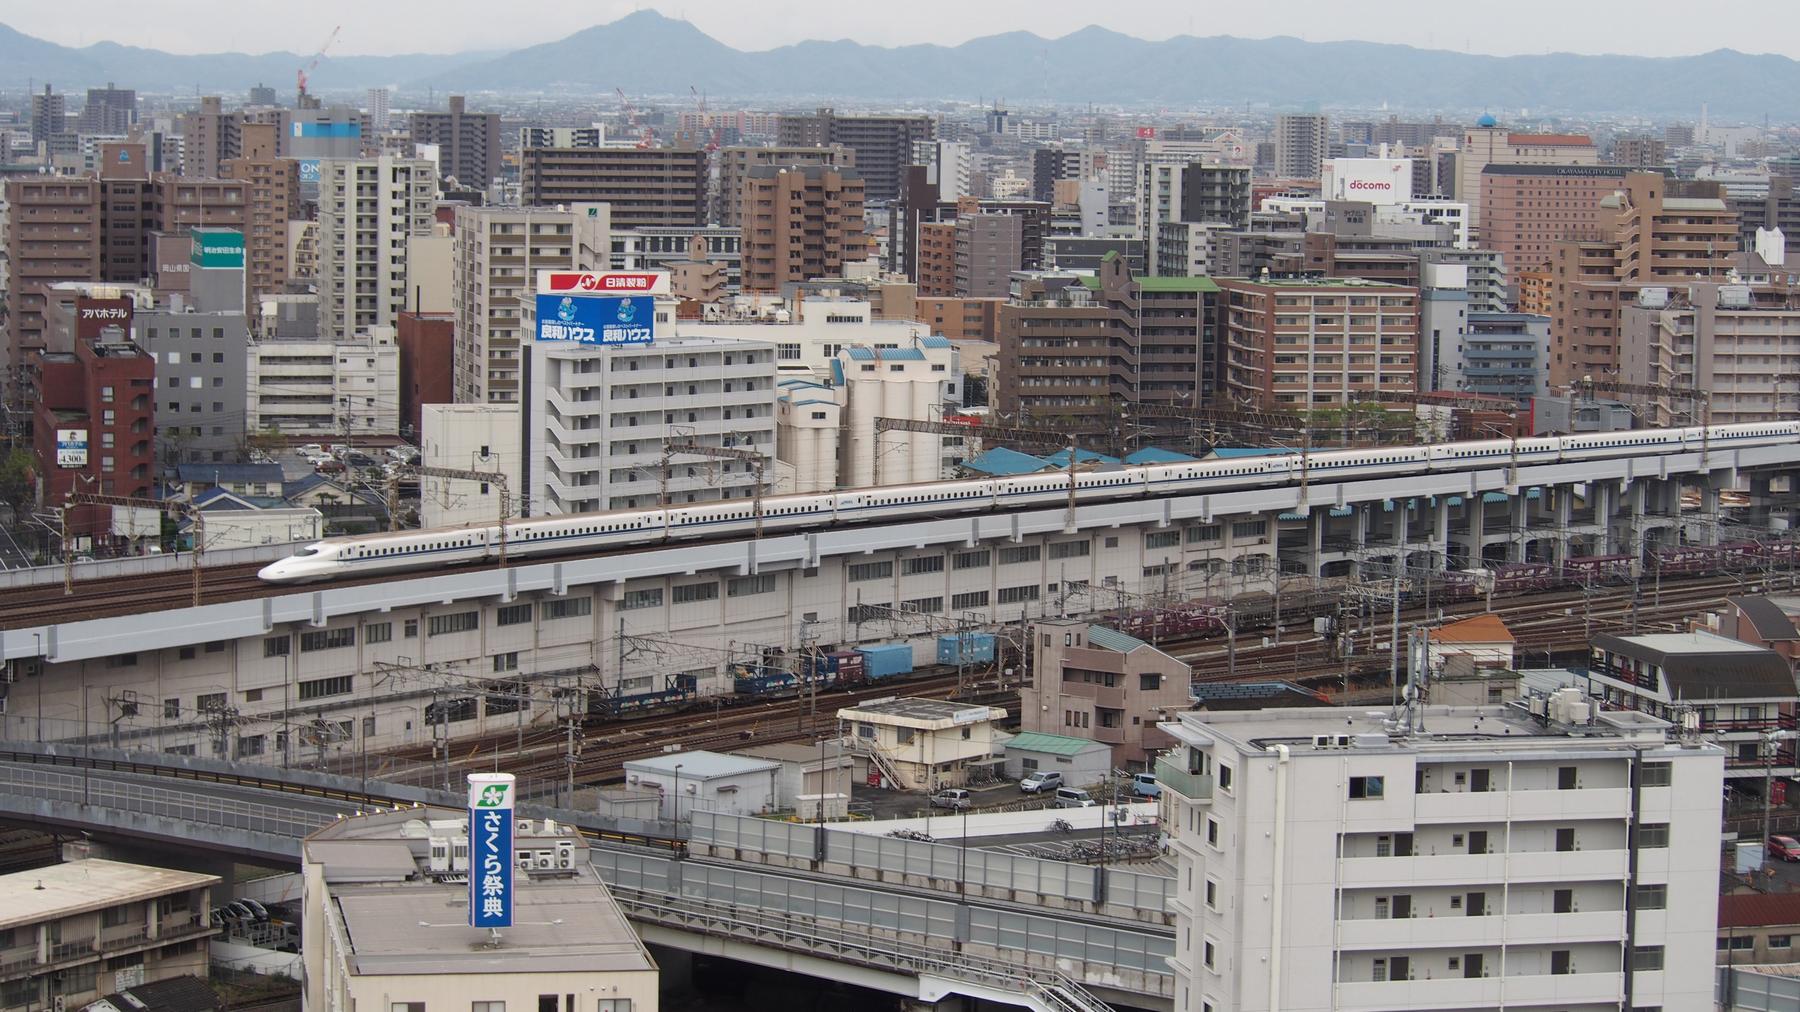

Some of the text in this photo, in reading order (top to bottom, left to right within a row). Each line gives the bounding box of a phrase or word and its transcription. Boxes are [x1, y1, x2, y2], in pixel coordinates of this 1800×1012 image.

[1557, 163, 1588, 175] OKAYAMA
[1588, 163, 1602, 175] CITY
[1350, 180, 1391, 190] docomo
[606, 277, 647, 288] 日清製粉
[82, 308, 128, 319] アパホテル
[541, 324, 595, 341] 良和ハウス
[603, 327, 651, 342] 良和ハウス
[482, 811, 504, 918] さくら祭典
